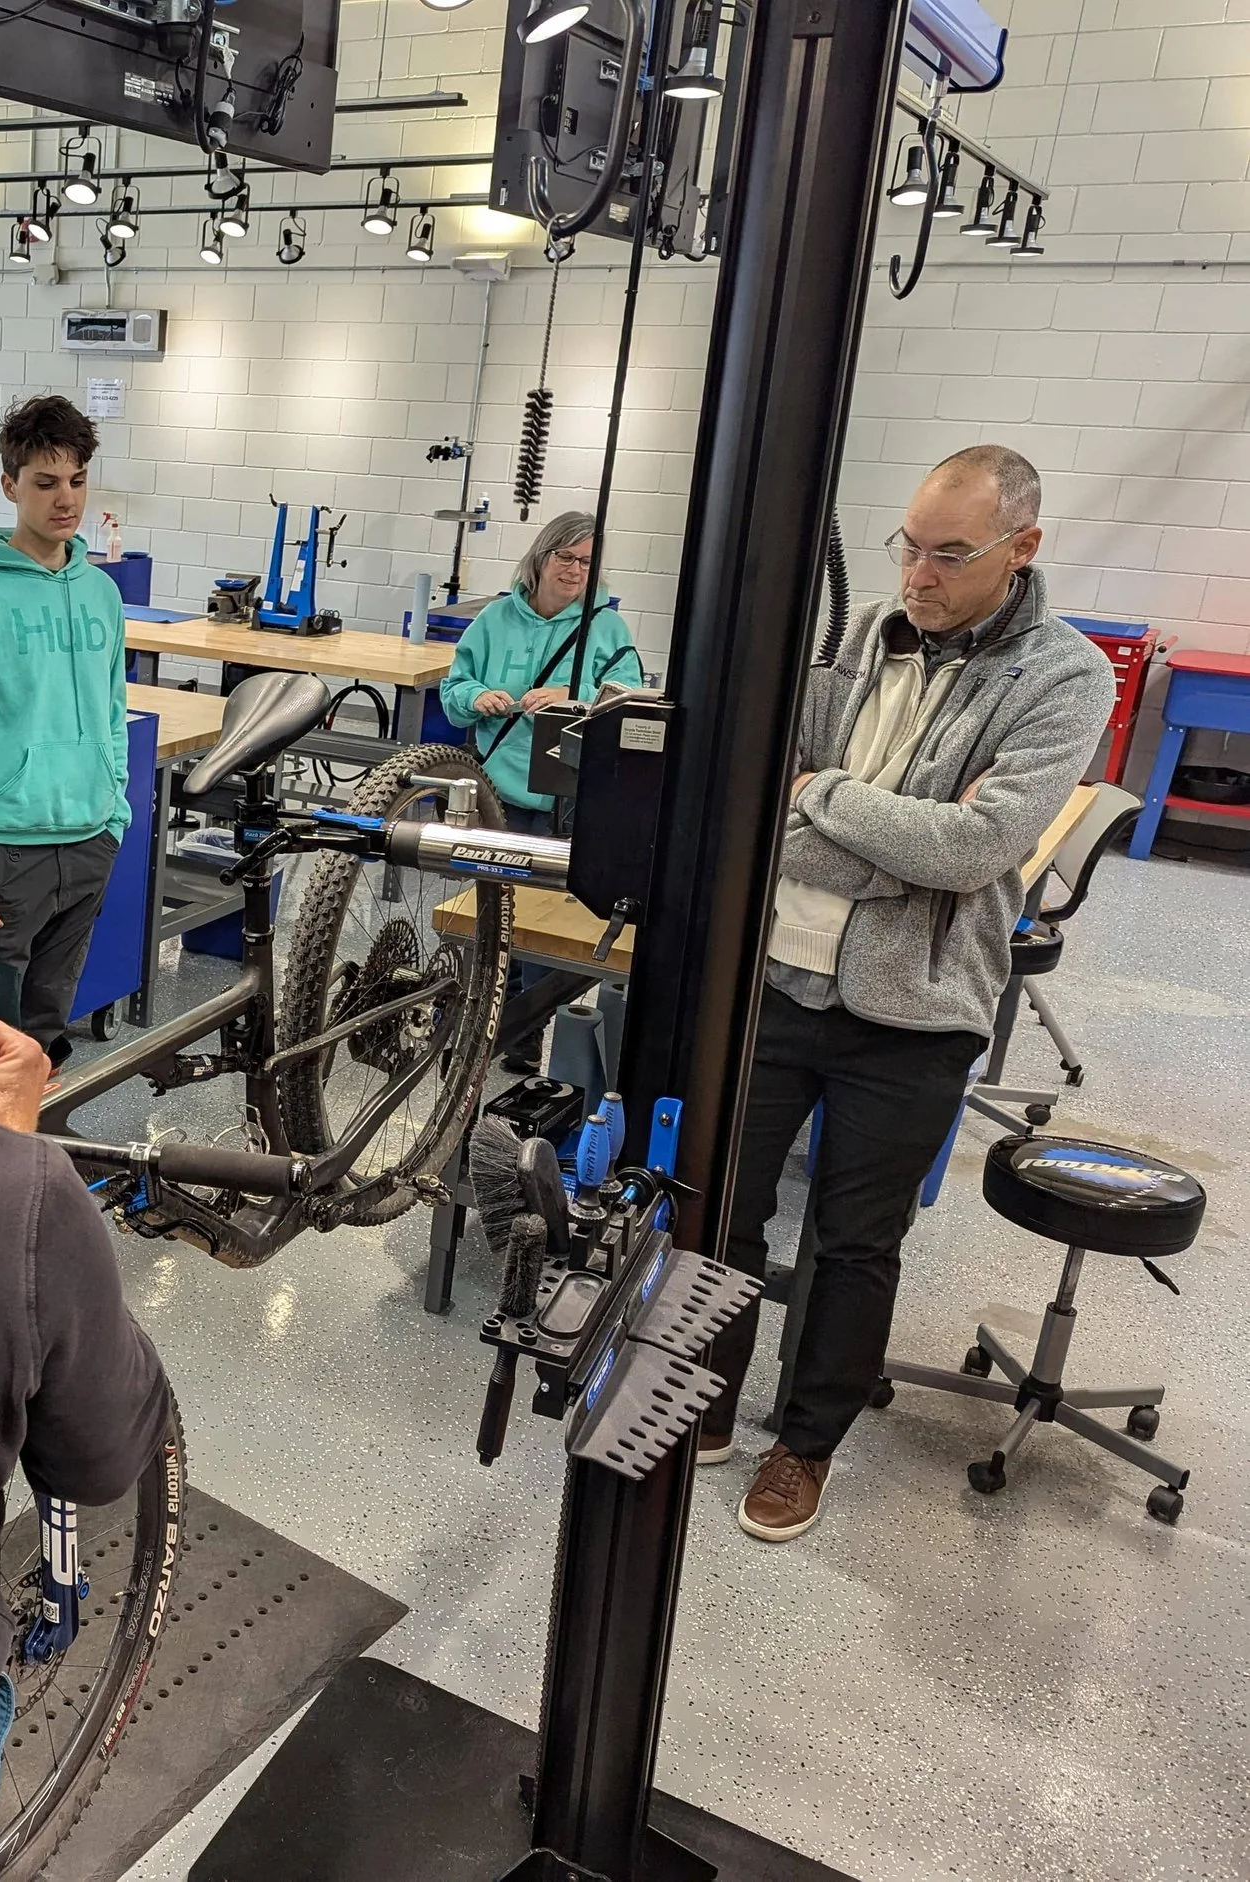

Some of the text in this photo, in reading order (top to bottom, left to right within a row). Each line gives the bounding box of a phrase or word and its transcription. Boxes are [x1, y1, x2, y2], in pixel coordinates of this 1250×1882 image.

[11, 603, 107, 655] Hub
[477, 865, 503, 874] PRS-33.2
[486, 893, 510, 1040] vittoria BARZO
[165, 1453, 179, 1513] vittoria
[148, 1522, 178, 1638] BARZO
